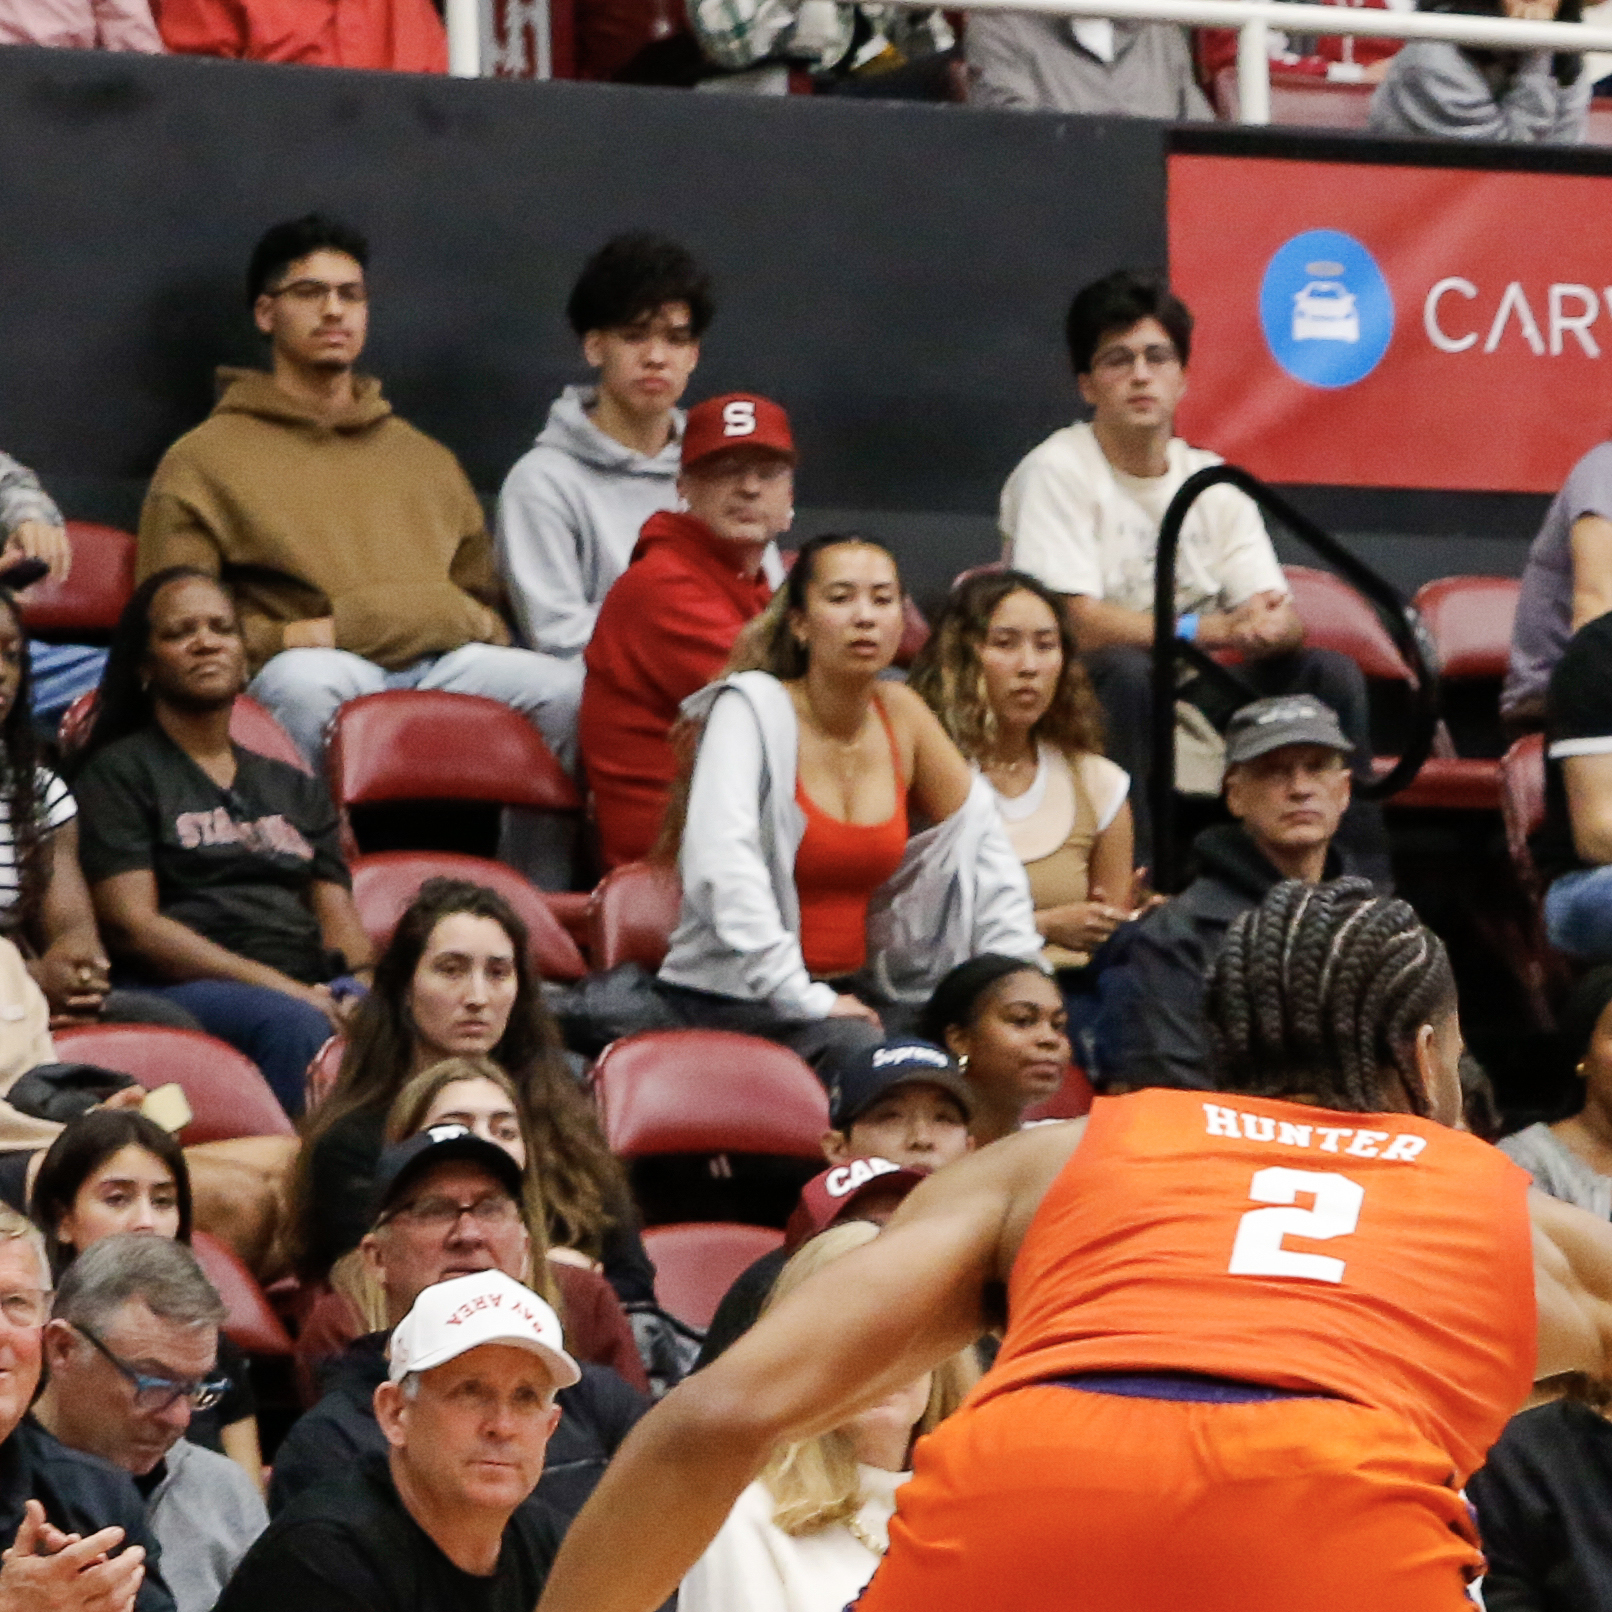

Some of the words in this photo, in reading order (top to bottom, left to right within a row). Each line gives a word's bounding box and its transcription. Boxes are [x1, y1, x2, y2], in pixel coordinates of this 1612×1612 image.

[722, 400, 757, 437] S
[1202, 1102, 1428, 1162] HUNTER
[1227, 1165, 1366, 1284] 2
[445, 1293, 504, 1327] AREA
